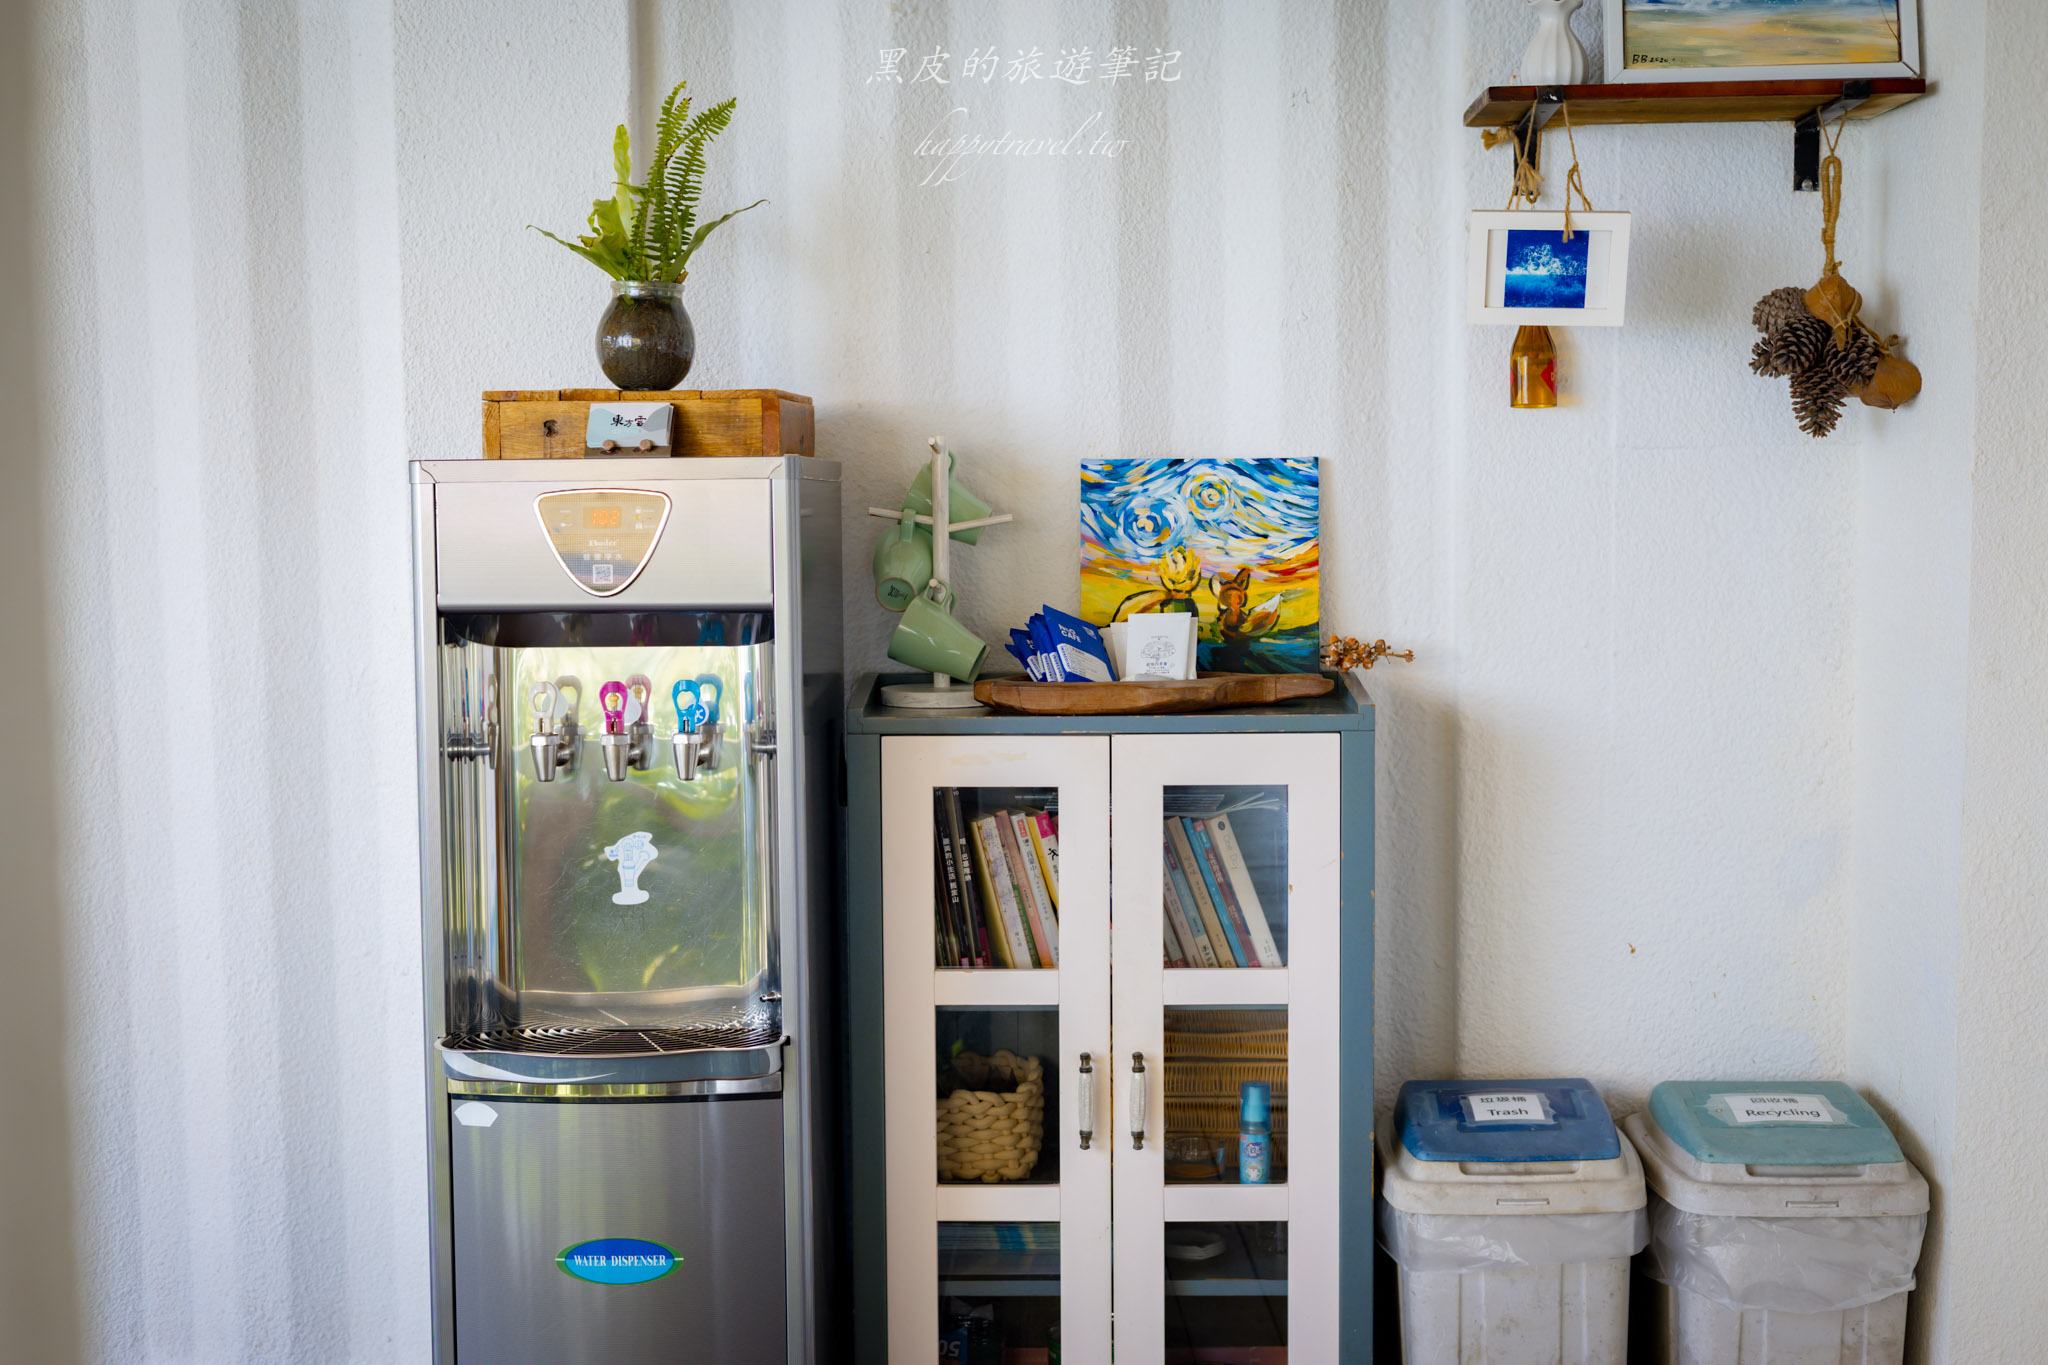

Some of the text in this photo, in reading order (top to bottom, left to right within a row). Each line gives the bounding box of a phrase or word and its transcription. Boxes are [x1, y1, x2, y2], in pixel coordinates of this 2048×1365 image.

[1486, 1107, 1529, 1117] Trash
[1745, 1107, 1821, 1119] Recycling
[574, 1254, 667, 1267] WATER DISPENSER
